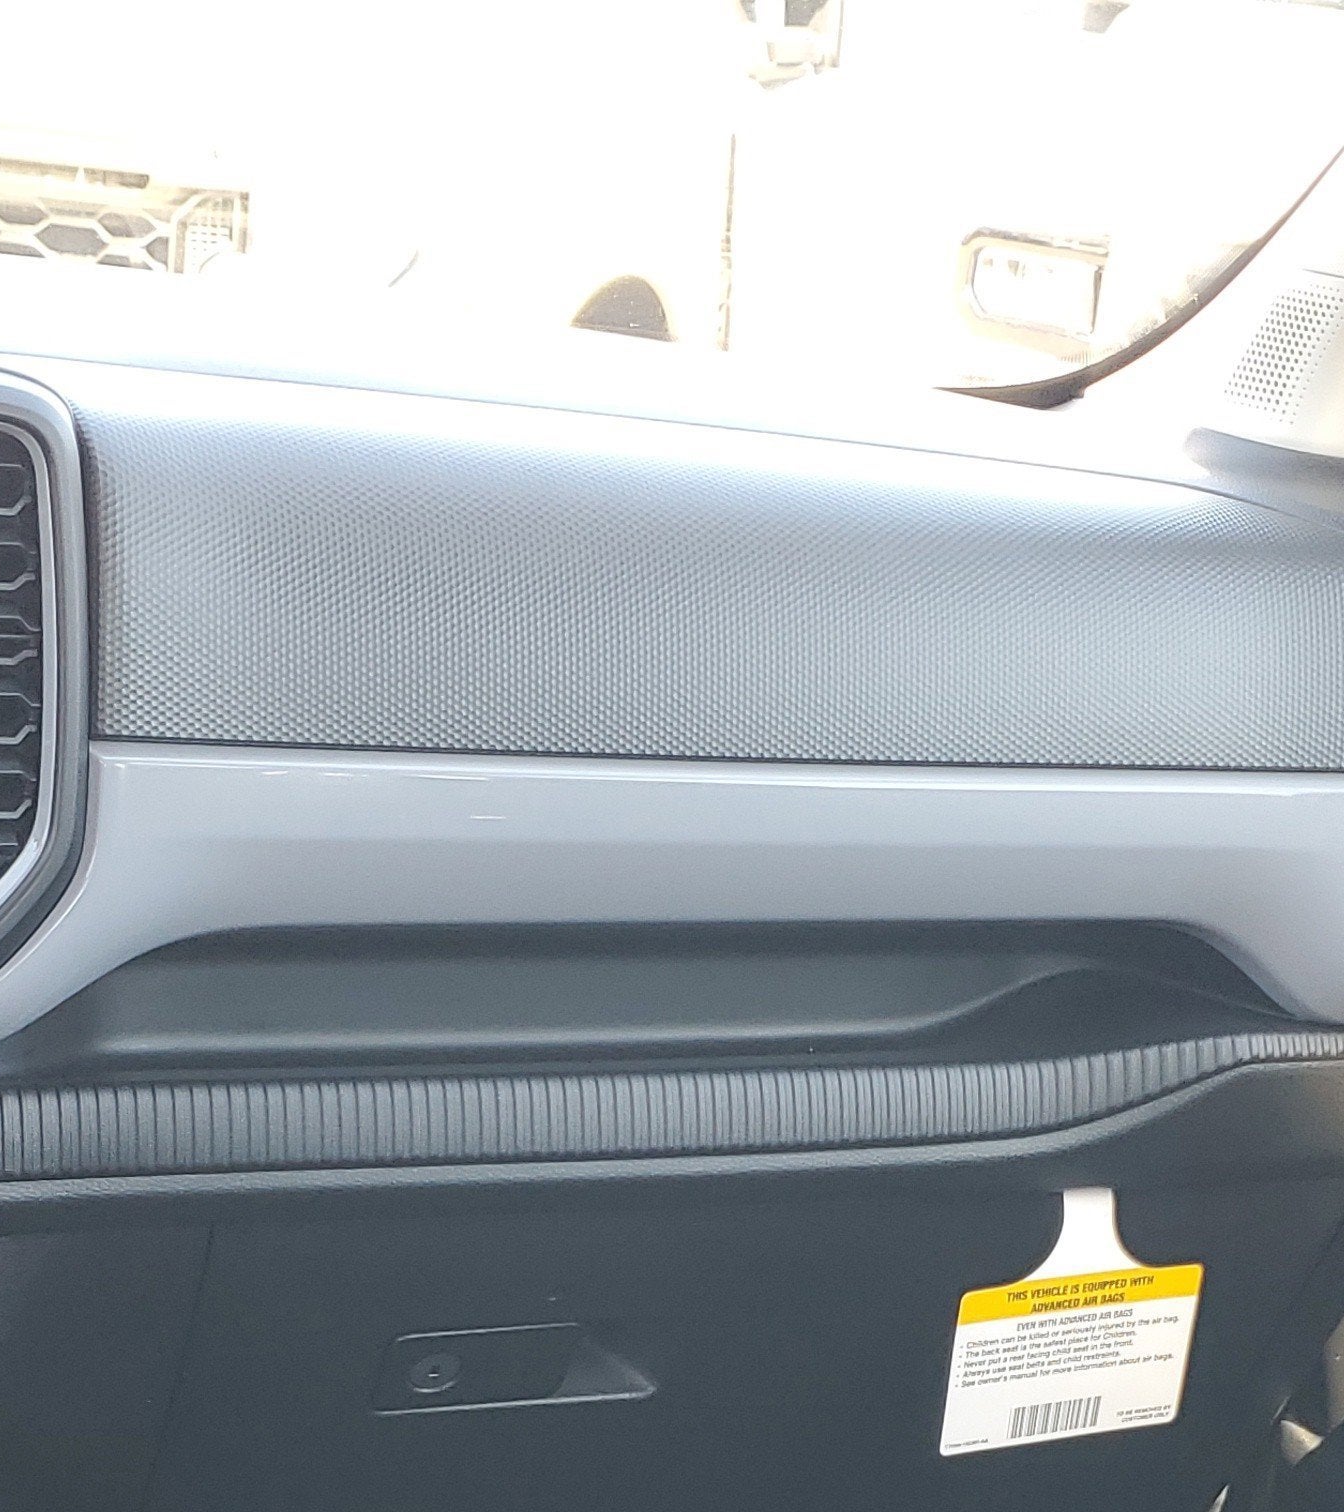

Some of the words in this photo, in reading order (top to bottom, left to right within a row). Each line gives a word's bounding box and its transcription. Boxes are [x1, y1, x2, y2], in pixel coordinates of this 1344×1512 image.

[1007, 1291, 1028, 1302] THIS
[1031, 1285, 1068, 1299] VEHICLE
[1070, 1284, 1079, 1294] IS
[1083, 1279, 1127, 1292] EQUIPPED
[1130, 1276, 1154, 1287] WITH
[1031, 1299, 1080, 1314] ADVANCED
[1082, 1296, 1097, 1306] AIR
[1101, 1293, 1125, 1303] BAGS
[1017, 1322, 1036, 1331] EVEN
[1038, 1318, 1057, 1329] WITH
[1058, 1313, 1096, 1325] ADVANCED
[1099, 1311, 1111, 1319] AIR
[1114, 1309, 1133, 1318] BAGS
[965, 1351, 979, 1359] The
[982, 1347, 1000, 1356] back
[1002, 1345, 1018, 1353] seat
[1020, 1343, 1027, 1351] is
[1029, 1341, 1041, 1349] the
[1043, 1338, 1066, 1348] safest
[1068, 1335, 1088, 1345] place
[1090, 1333, 1101, 1341] for
[967, 1338, 999, 1349] Children
[1017, 1333, 1026, 1342] be
[1029, 1331, 1050, 1340] killed
[1061, 1325, 1096, 1336] seriously
[1098, 1321, 1124, 1332] injured
[1126, 1320, 1136, 1328] by
[1138, 1318, 1150, 1326] the
[963, 1368, 990, 1378] Always
[1008, 1363, 1024, 1371] seat
[1026, 1359, 1045, 1368] belts
[1047, 1357, 1061, 1365] and
[1063, 1354, 1081, 1363] child
[964, 1360, 986, 1369] Never
[988, 1356, 1001, 1366] put
[1027, 1350, 1050, 1359] facing
[1052, 1346, 1071, 1356] child
[1073, 1345, 1089, 1353] seat
[1099, 1341, 1111, 1349] the
[961, 1380, 975, 1388] See
[1009, 1370, 1038, 1380] manual
[1040, 1368, 1050, 1377] for
[1052, 1366, 1072, 1375] more
[1074, 1361, 1117, 1372] information
[1119, 1357, 1140, 1366] about
